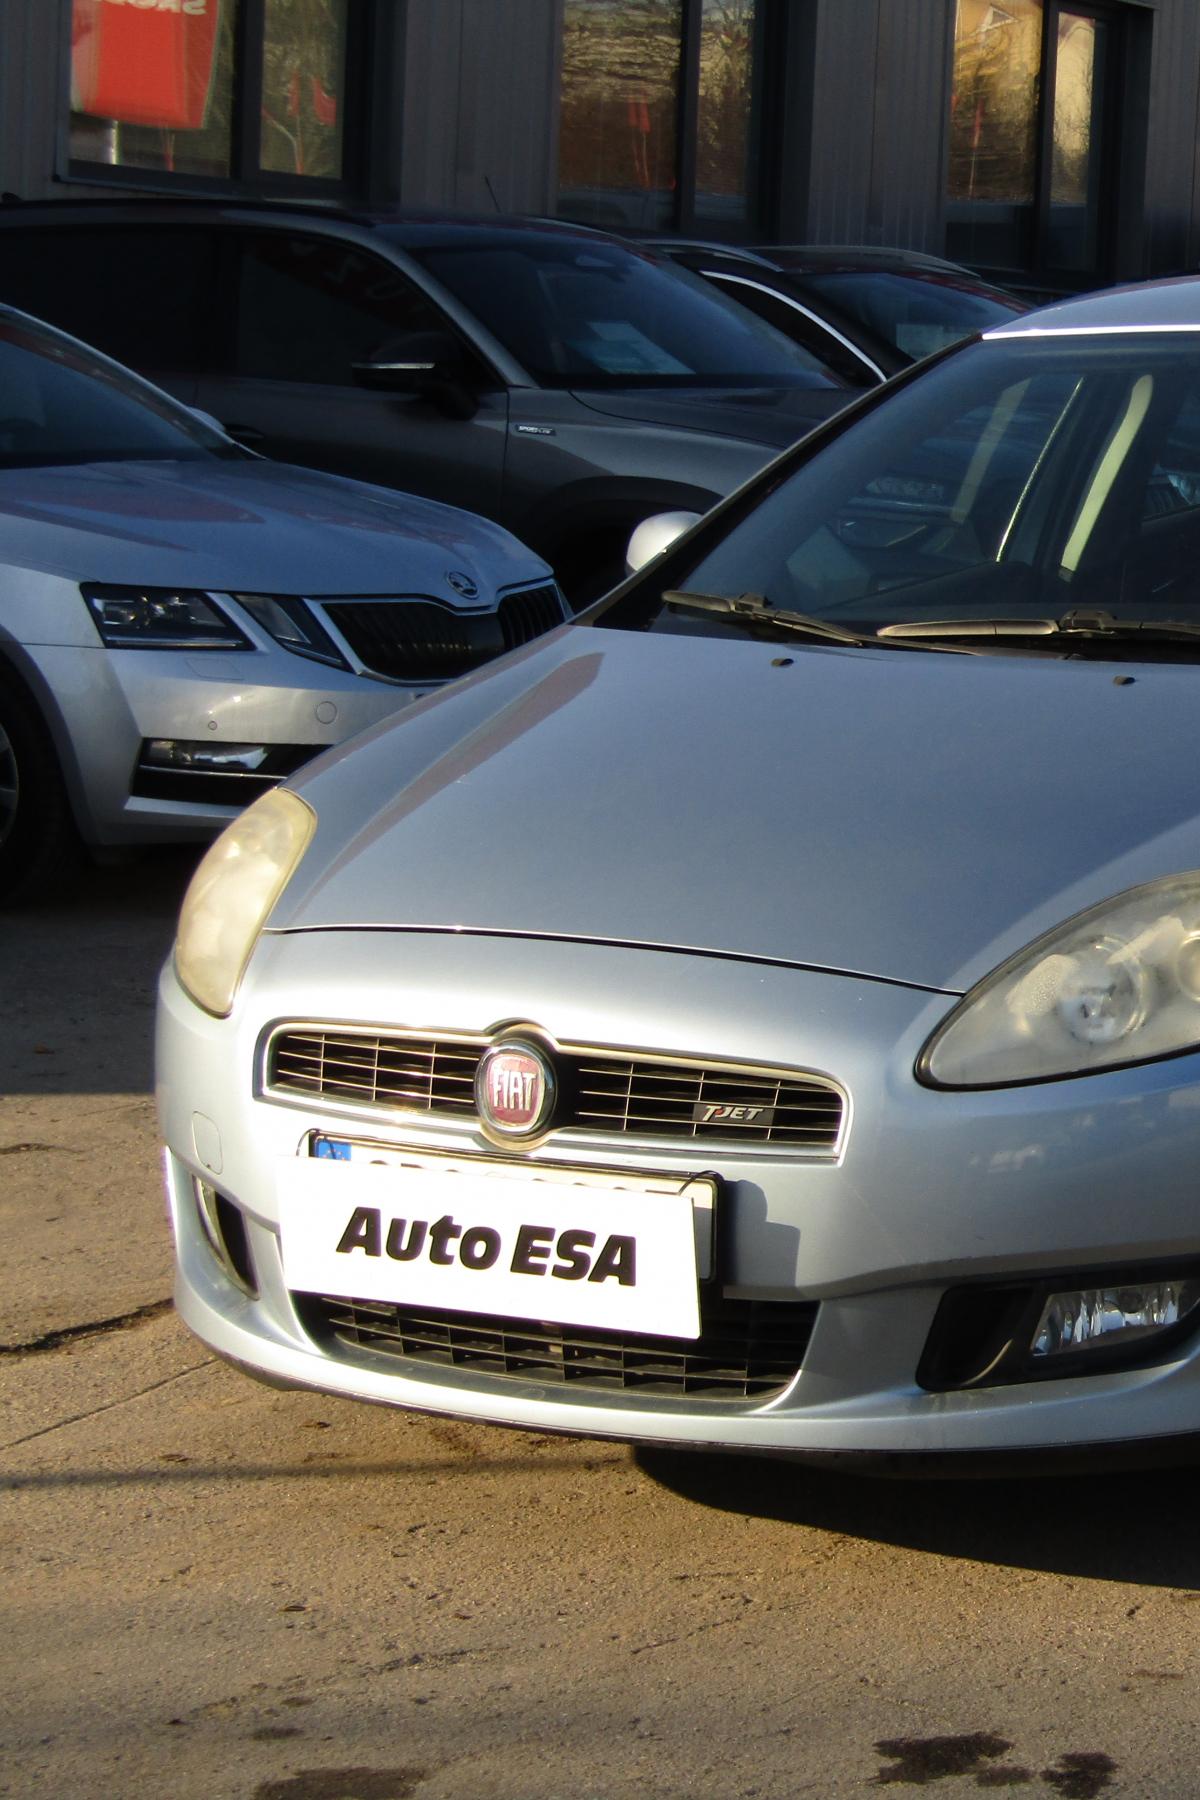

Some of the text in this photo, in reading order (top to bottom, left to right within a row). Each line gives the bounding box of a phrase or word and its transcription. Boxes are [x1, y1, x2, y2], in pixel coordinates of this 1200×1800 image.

[492, 1067, 537, 1111] FIAT
[336, 1206, 636, 1286] Auto ESA
